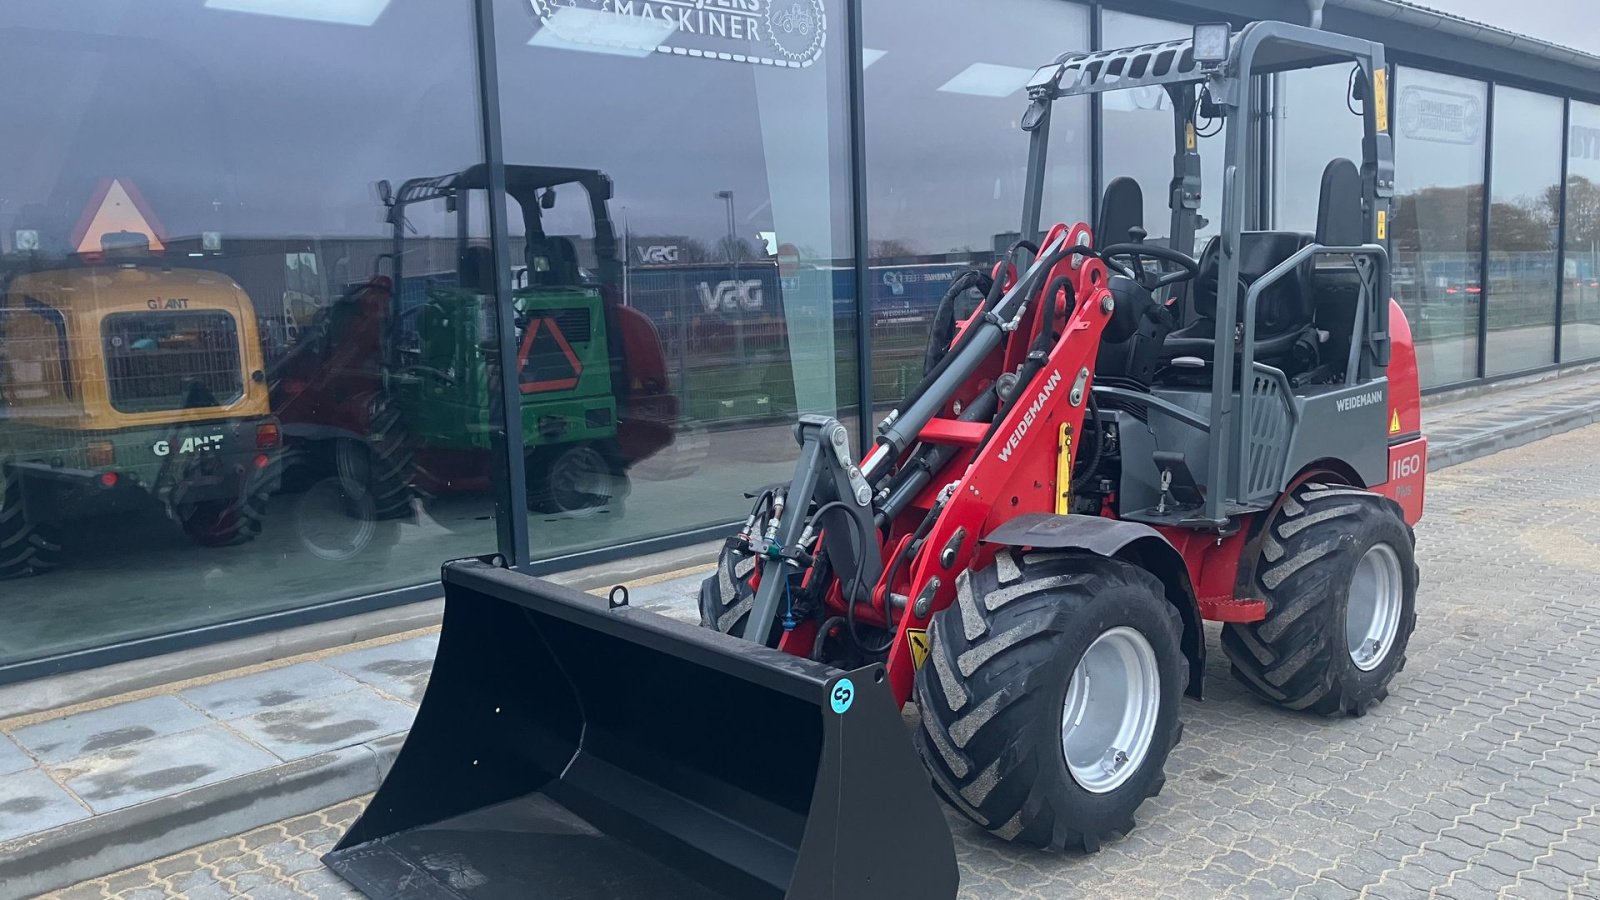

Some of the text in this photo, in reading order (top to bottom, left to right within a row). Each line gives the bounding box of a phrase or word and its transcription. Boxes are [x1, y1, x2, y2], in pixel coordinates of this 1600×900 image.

[614, 0, 761, 41] MASKINER
[147, 297, 189, 309] GIANT
[1336, 390, 1382, 412] WEIDEMANN
[998, 368, 1062, 462] WEIDEMANN
[1392, 454, 1420, 480] 1160
